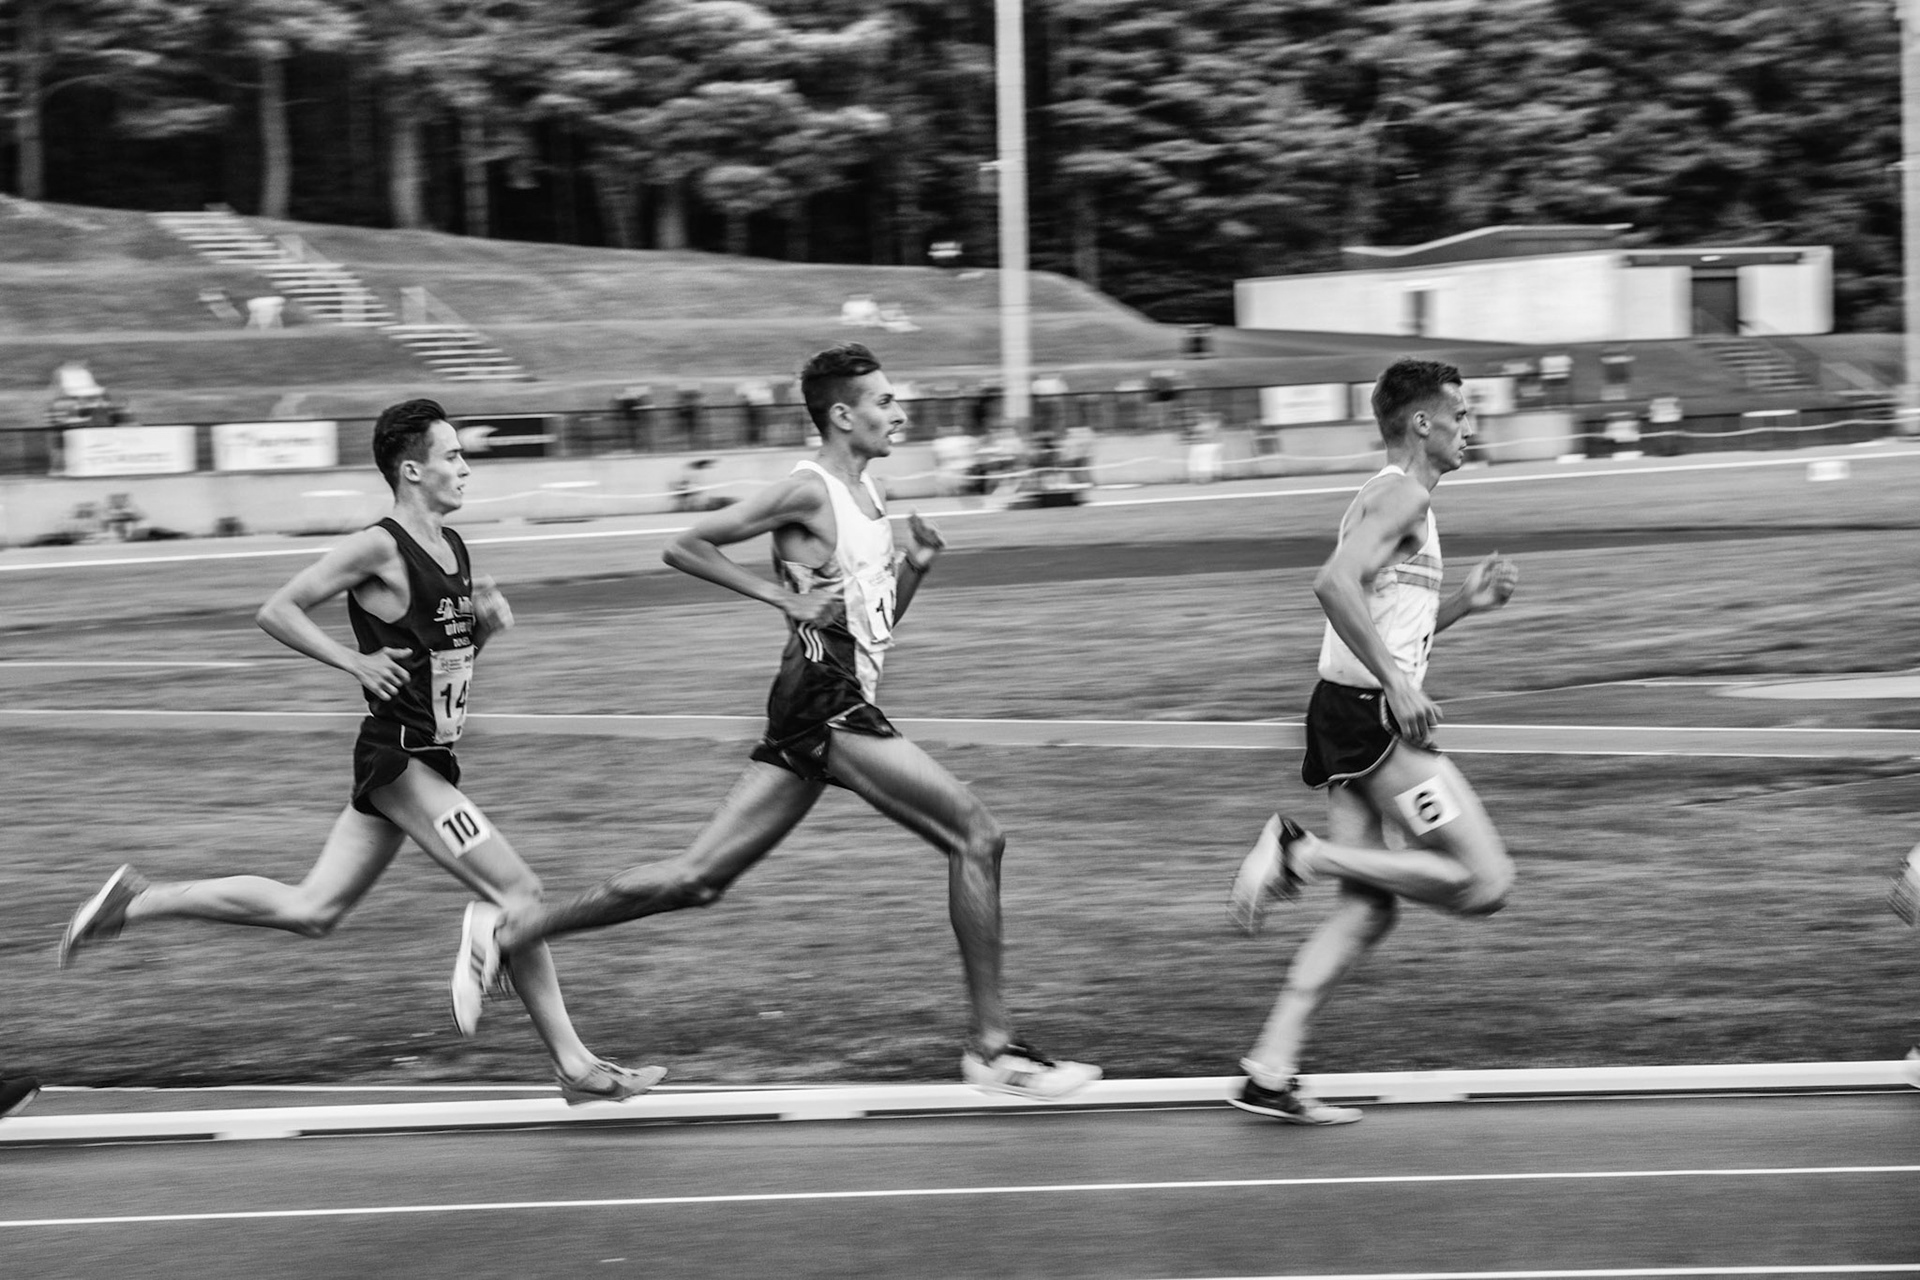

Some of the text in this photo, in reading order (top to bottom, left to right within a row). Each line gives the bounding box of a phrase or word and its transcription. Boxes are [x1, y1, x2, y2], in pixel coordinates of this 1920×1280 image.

[440, 680, 467, 718] 14
[1413, 790, 1442, 823] 6
[442, 811, 480, 846] 10
